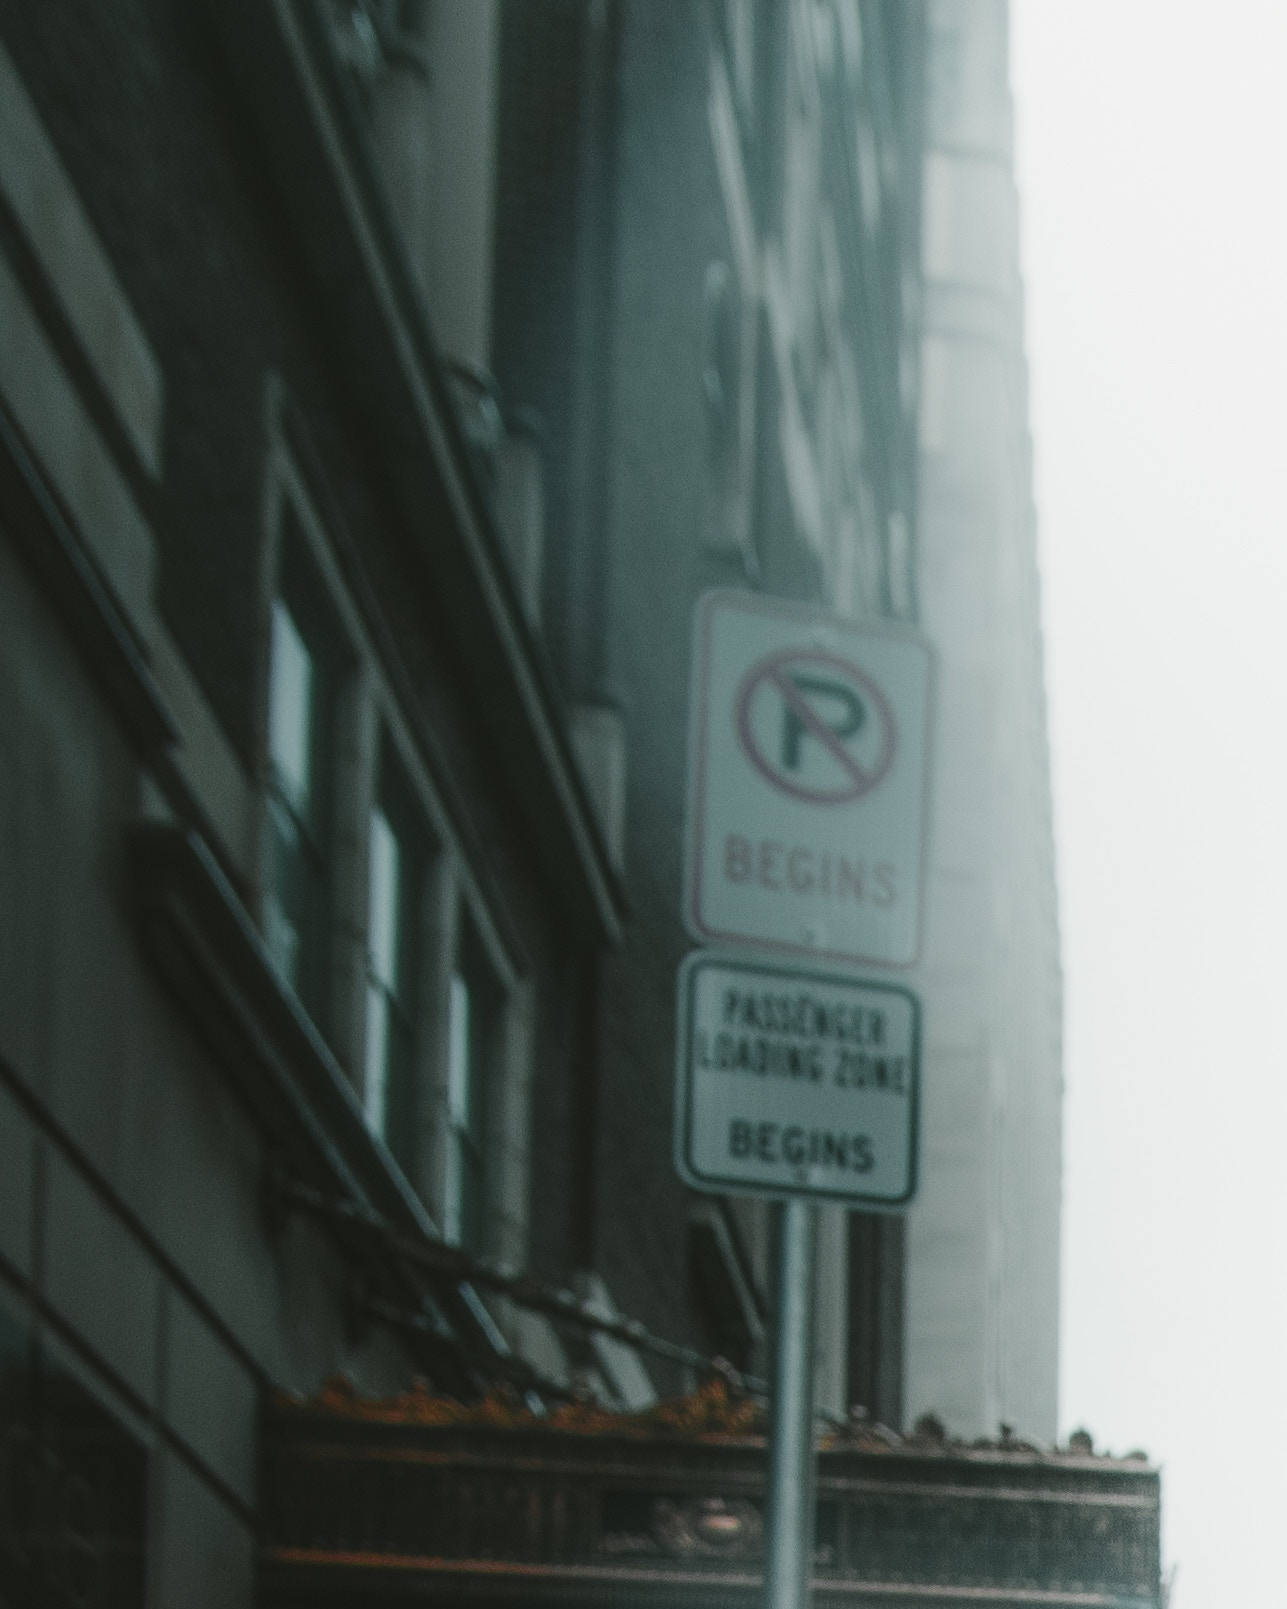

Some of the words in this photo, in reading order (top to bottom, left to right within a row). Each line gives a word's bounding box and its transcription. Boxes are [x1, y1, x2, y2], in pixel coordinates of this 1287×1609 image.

[721, 832, 899, 912] BEGINS
[722, 988, 888, 1045] PASSENGER
[695, 1030, 825, 1082] LOADING
[833, 1047, 908, 1094] ZONE
[728, 1117, 876, 1176] BEGINS
